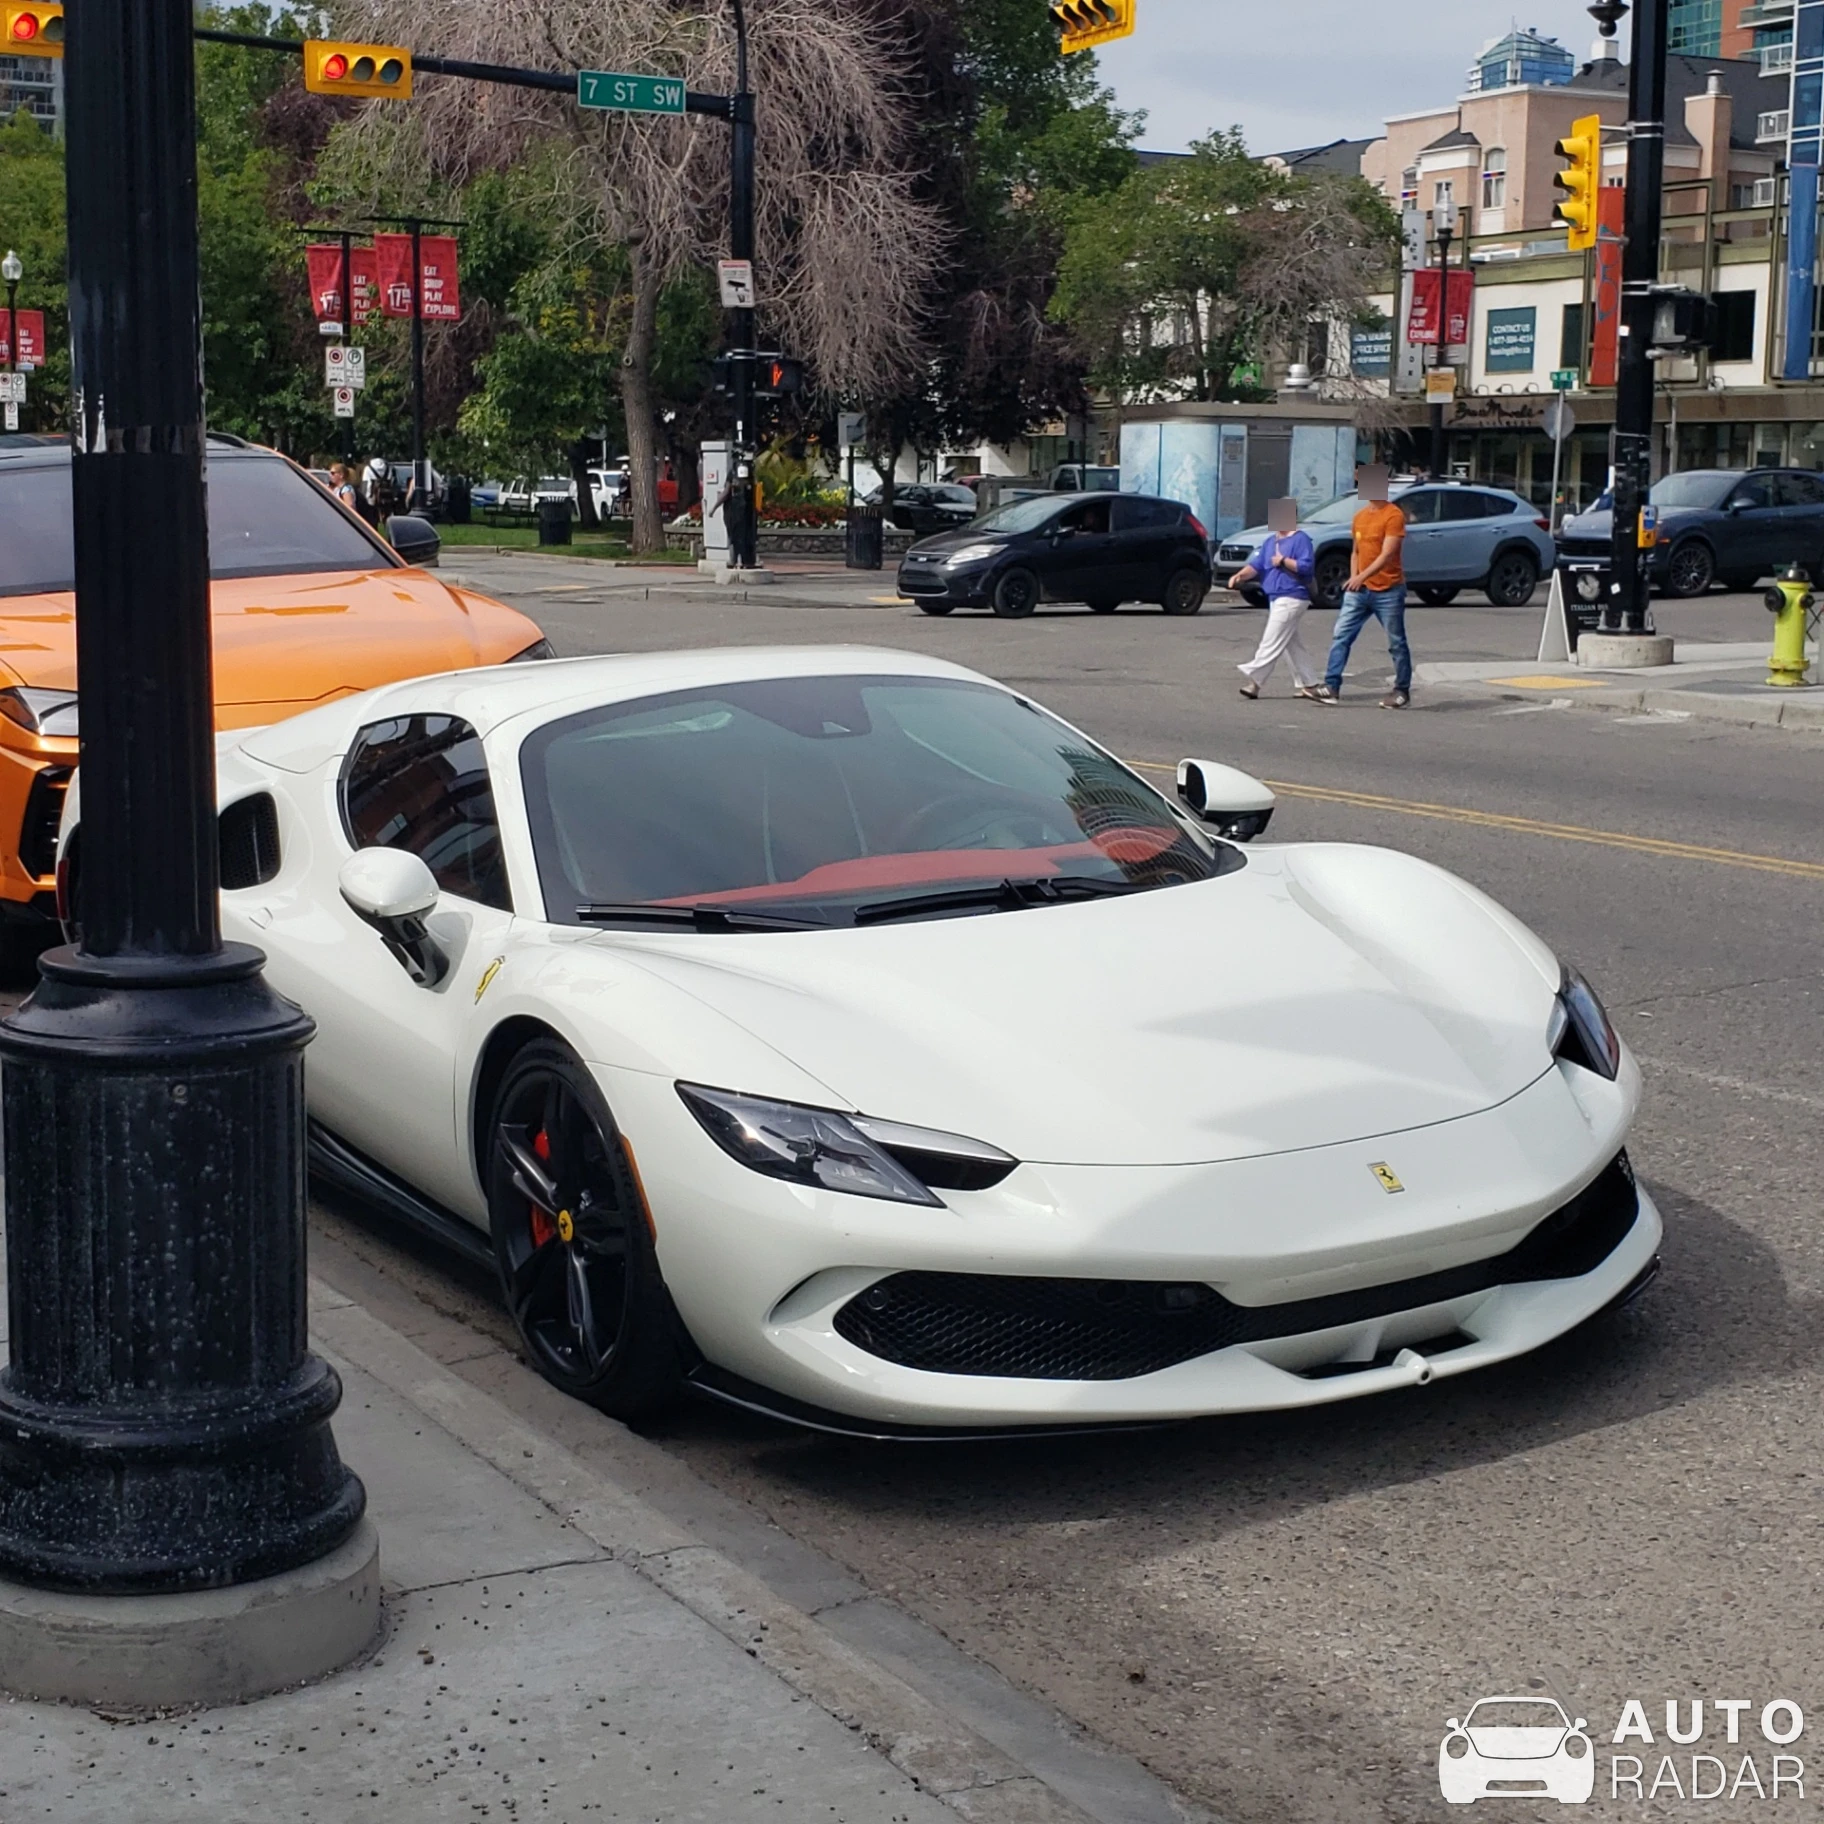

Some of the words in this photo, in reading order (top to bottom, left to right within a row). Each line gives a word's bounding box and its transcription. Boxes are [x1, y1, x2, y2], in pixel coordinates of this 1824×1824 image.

[585, 79, 598, 99] 7
[613, 81, 638, 103] ST
[653, 84, 681, 106] SW
[424, 265, 437, 276] EAT
[425, 291, 443, 302] PLAY
[353, 299, 371, 309] PLAY
[425, 304, 456, 316] EXPLORE
[1492, 324, 1520, 334] CONTACT
